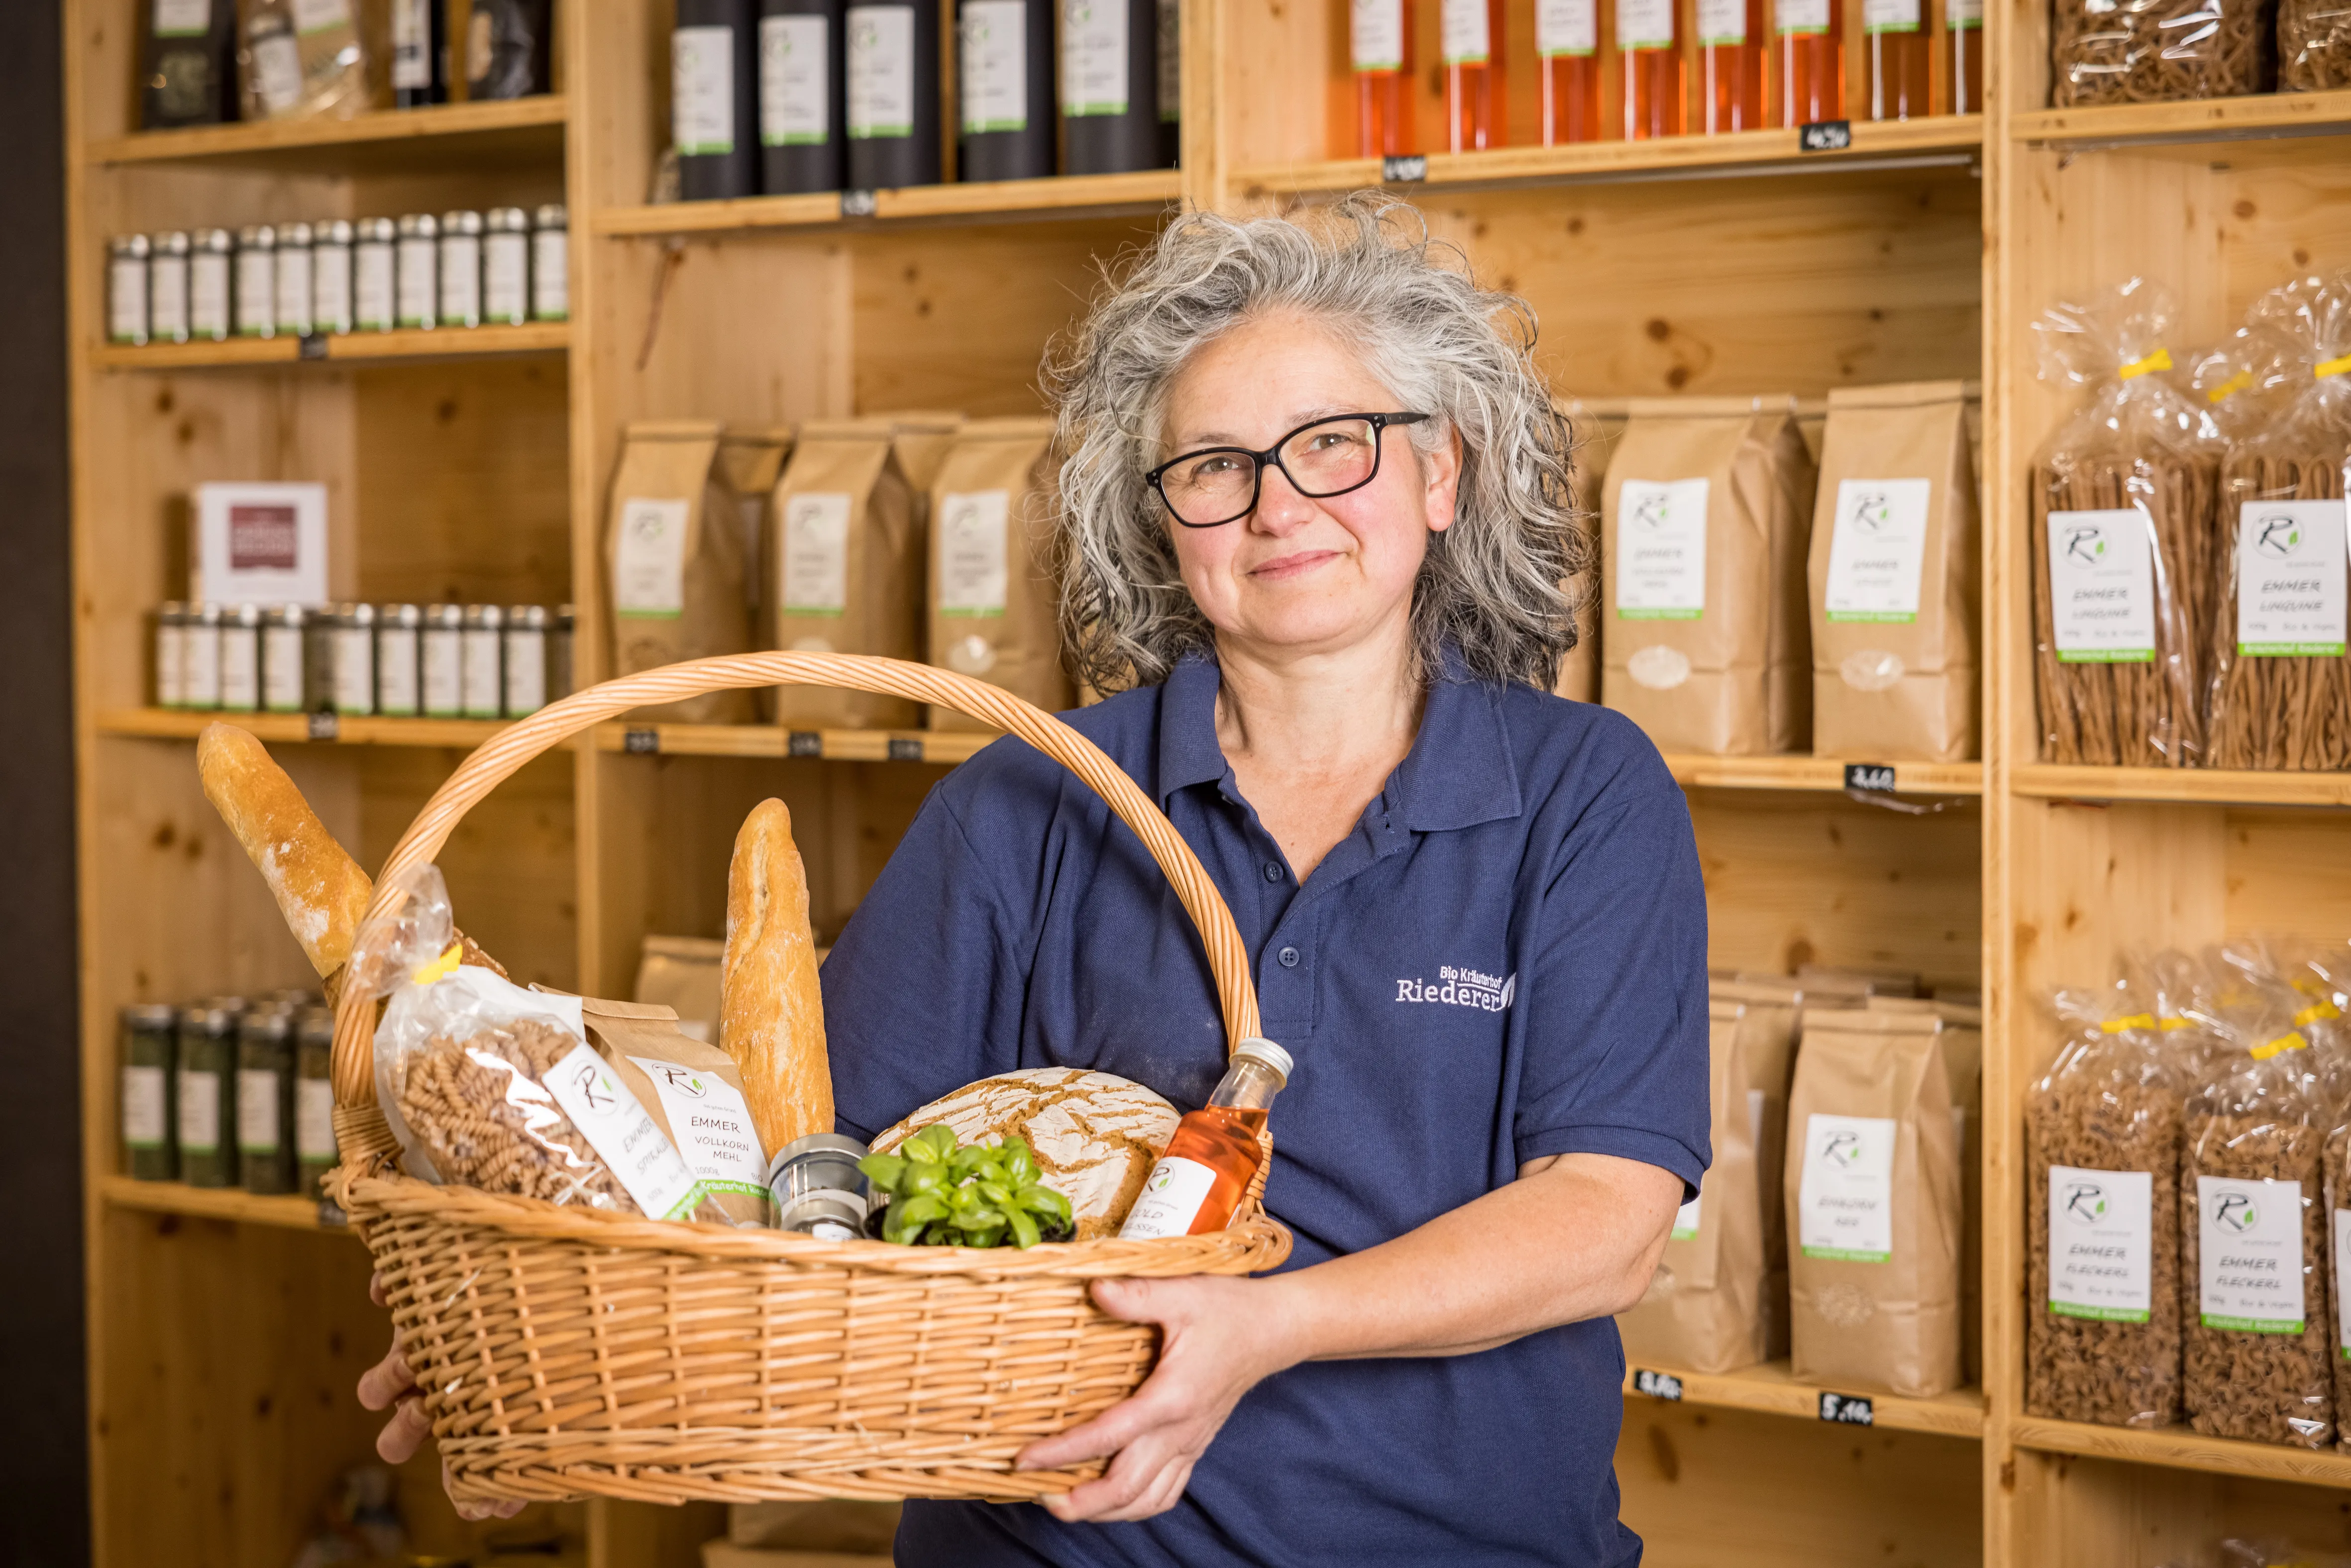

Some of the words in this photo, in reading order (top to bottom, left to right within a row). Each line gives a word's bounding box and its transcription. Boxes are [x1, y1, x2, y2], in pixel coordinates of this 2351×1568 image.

[2261, 579, 2320, 593] EMMER
[2072, 587, 2129, 601] EMMER
[2071, 606, 2131, 620] LINGUINE
[2259, 600, 2323, 615] LINGUINE
[1440, 965, 1458, 980] Bio
[1460, 967, 1502, 989] Kräuterhof
[1395, 978, 1500, 1012] Riederer
[691, 1116, 741, 1134] EMMER
[623, 1116, 656, 1153] EMMER
[694, 1136, 749, 1152] VOLLKORN
[713, 1150, 742, 1162] MEHL
[695, 1166, 720, 1176] 1000g
[751, 1172, 763, 1183] BIO
[699, 1179, 747, 1193] Kräuterhof
[2069, 1244, 2127, 1259] EMMER
[2219, 1255, 2278, 1271] EMMER
[2065, 1263, 2130, 1279] FLECKERL
[2216, 1275, 2283, 1290] FLECKERL
